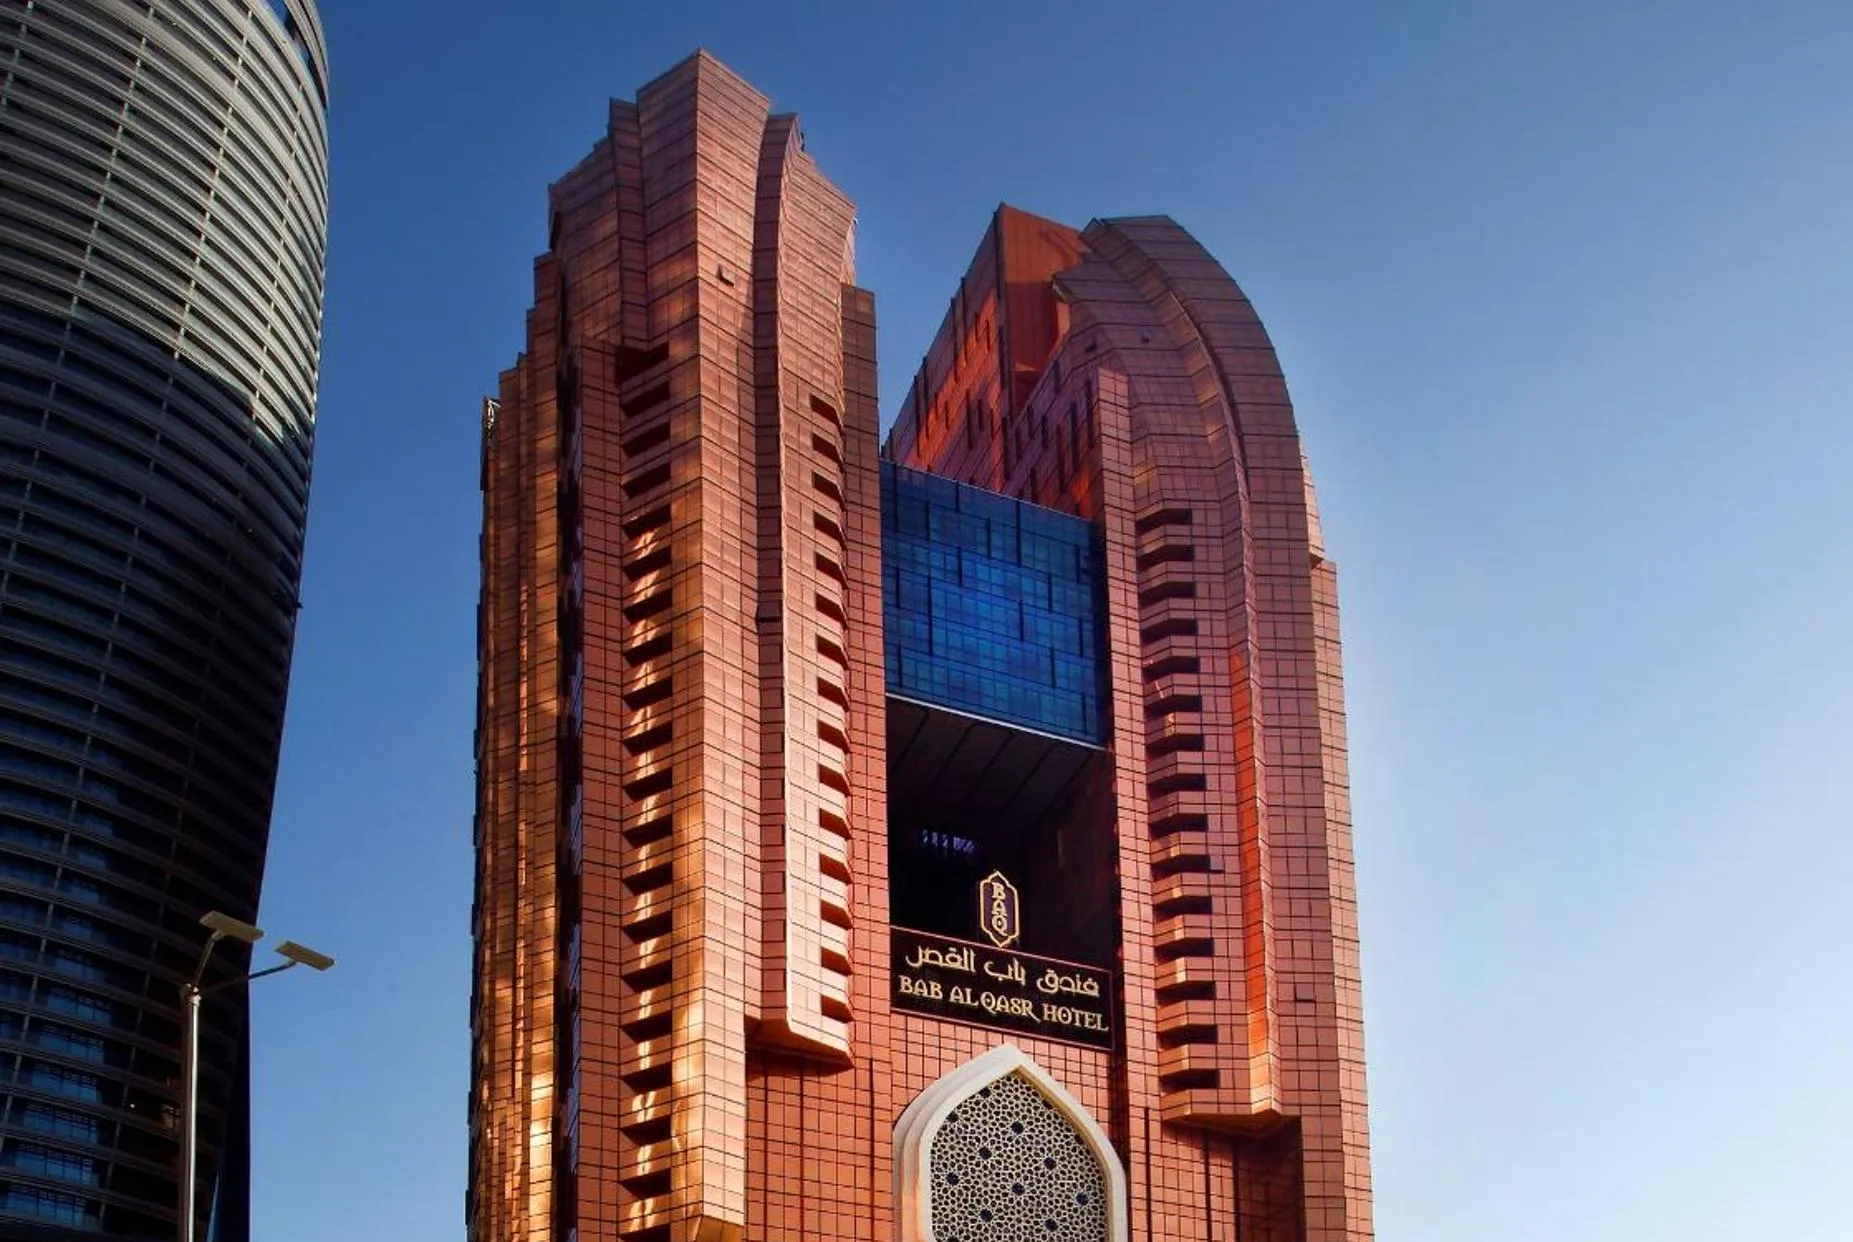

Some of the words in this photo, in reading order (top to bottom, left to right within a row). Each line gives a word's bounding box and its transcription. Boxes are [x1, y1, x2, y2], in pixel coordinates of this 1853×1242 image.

[991, 882, 1008, 937] BAQ
[905, 945, 976, 974] القصر
[984, 957, 1026, 987] باب
[1036, 969, 1100, 998] فندق
[899, 975, 943, 1000] BAB
[950, 986, 979, 1007] AL
[980, 992, 1041, 1023] QASR
[1043, 1003, 1109, 1032] HOTEL
